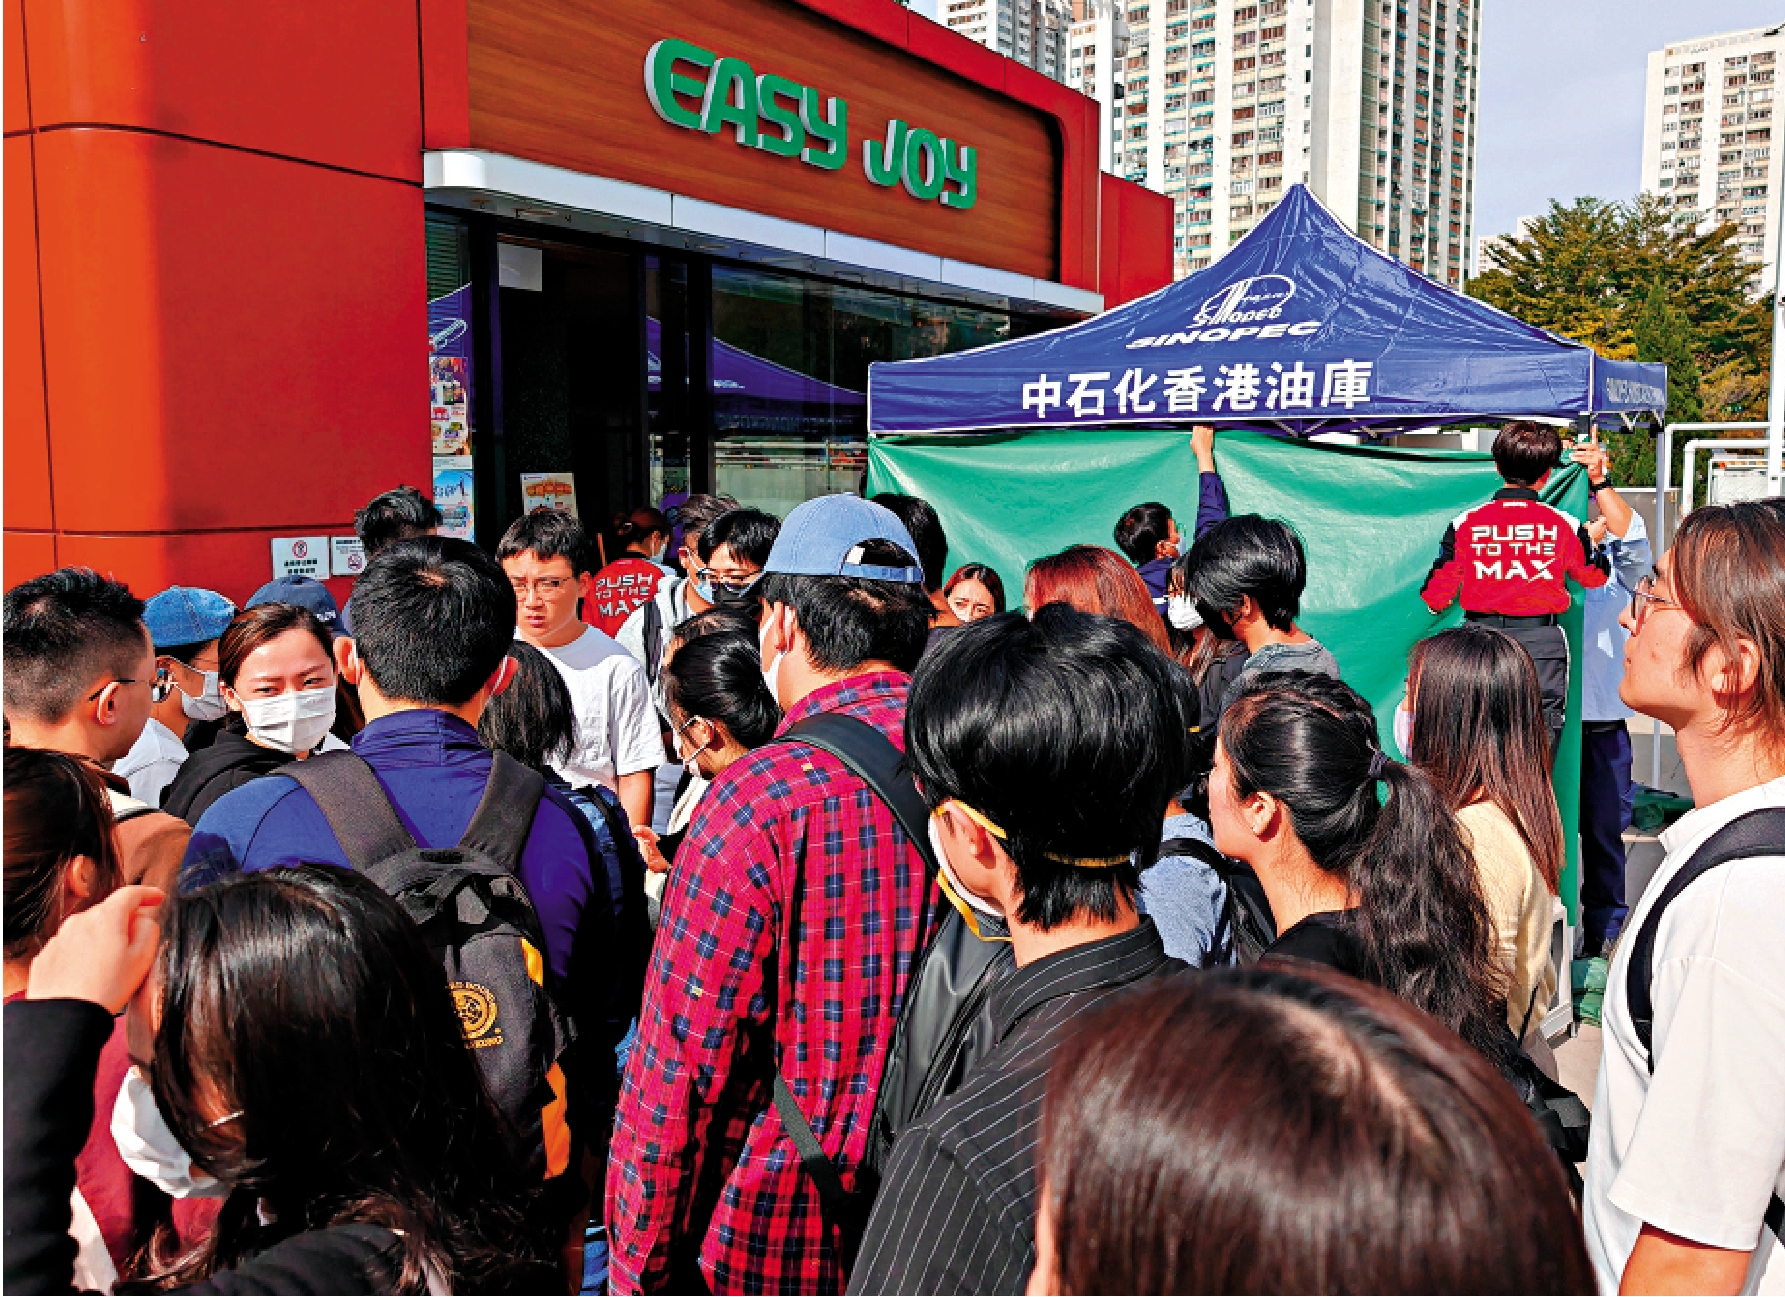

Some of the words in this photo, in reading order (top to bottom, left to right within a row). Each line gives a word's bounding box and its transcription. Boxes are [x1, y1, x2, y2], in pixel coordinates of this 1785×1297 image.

[644, 38, 847, 170] EASY
[863, 119, 977, 209] JOY
[1126, 321, 1322, 350] SINOPEC
[1022, 359, 1373, 418] 中石化香港油庫
[1470, 523, 1558, 541] PUSH
[1470, 541, 1502, 556] TO
[1508, 541, 1556, 556] THE
[1473, 557, 1556, 583] MAX
[595, 572, 654, 592] PUSH
[617, 585, 651, 598] THE
